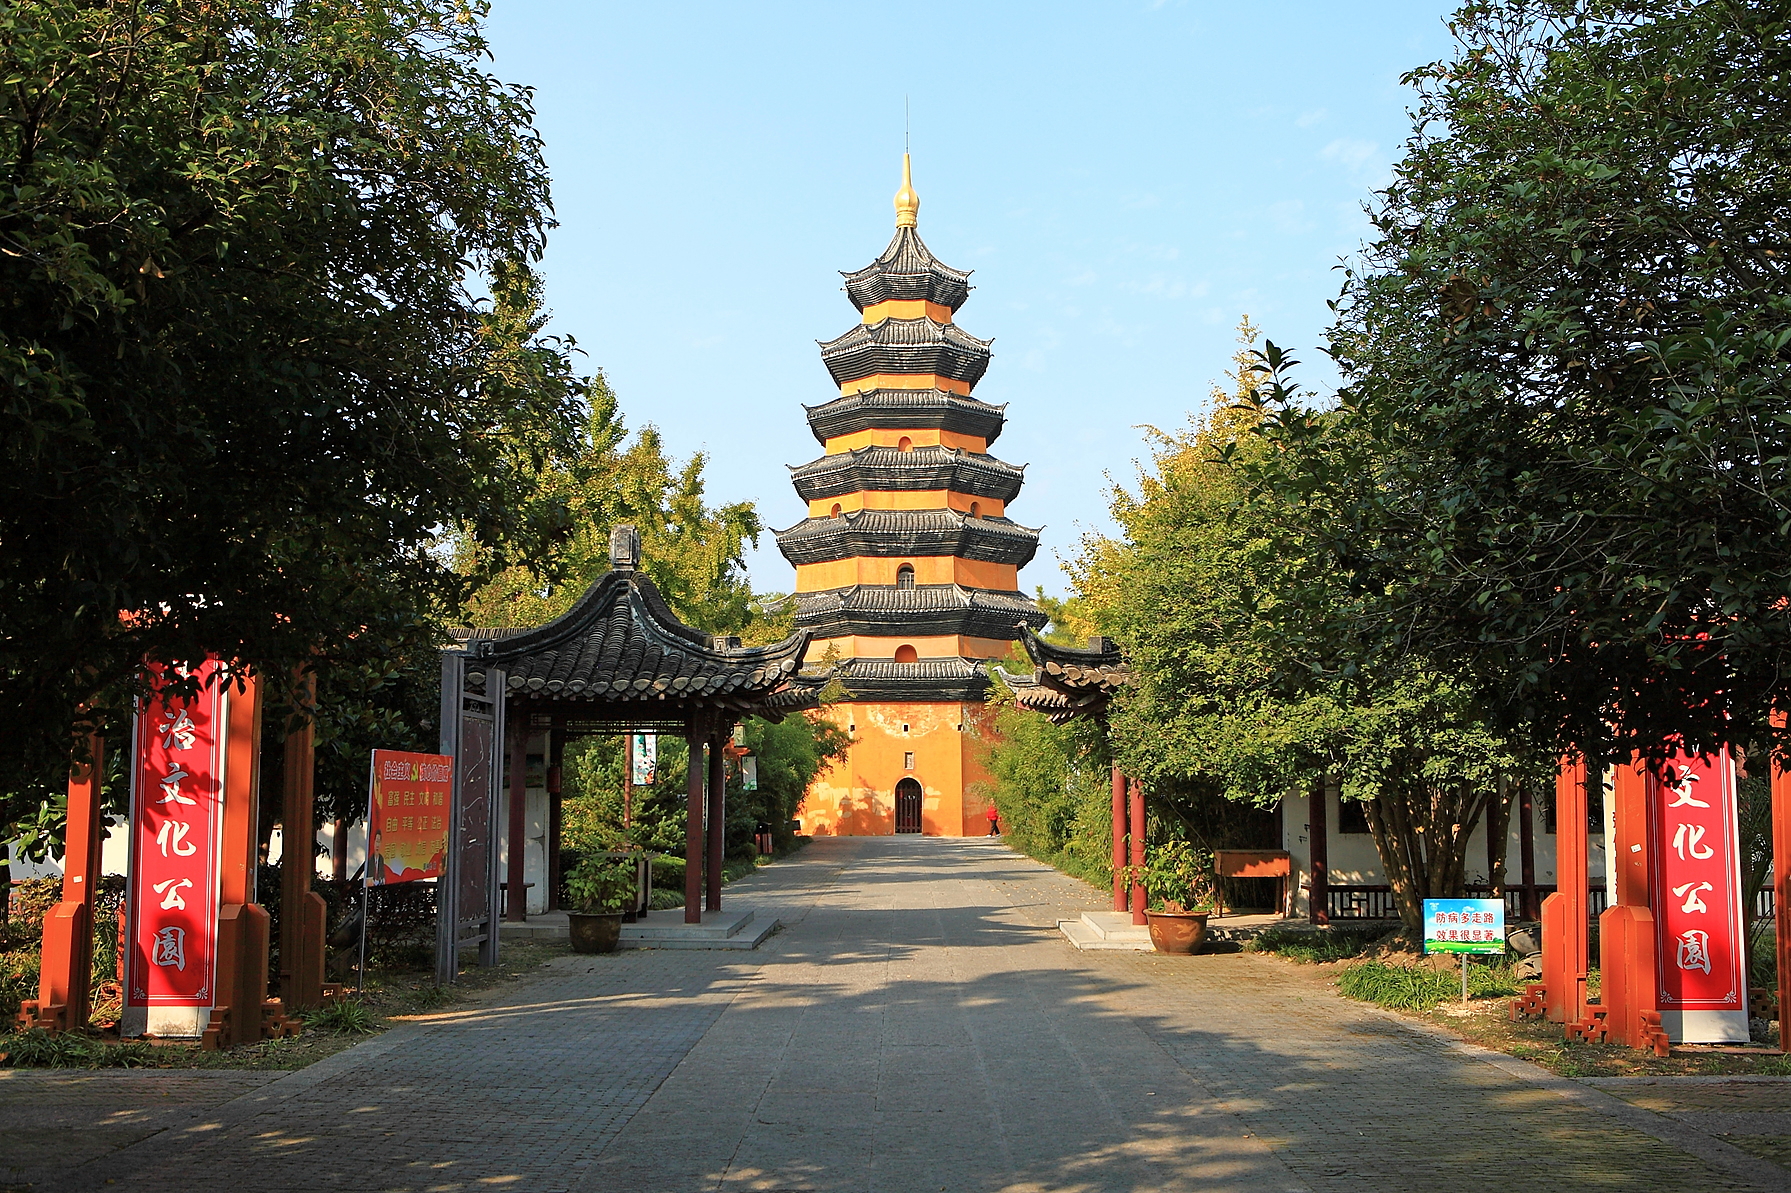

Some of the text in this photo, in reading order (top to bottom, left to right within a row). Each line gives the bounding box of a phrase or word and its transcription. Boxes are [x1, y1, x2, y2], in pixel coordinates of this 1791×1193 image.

[384, 760, 410, 780] 社会主义
[387, 790, 444, 807] 富强 民主 文明 和谐
[150, 658, 197, 972] 治文化公園
[385, 815, 442, 833] 自由 平等 公正 法治
[1667, 743, 1715, 976] 文化公園
[1435, 912, 1494, 924] 防病多走路
[1436, 929, 1494, 941] 效果很显著
